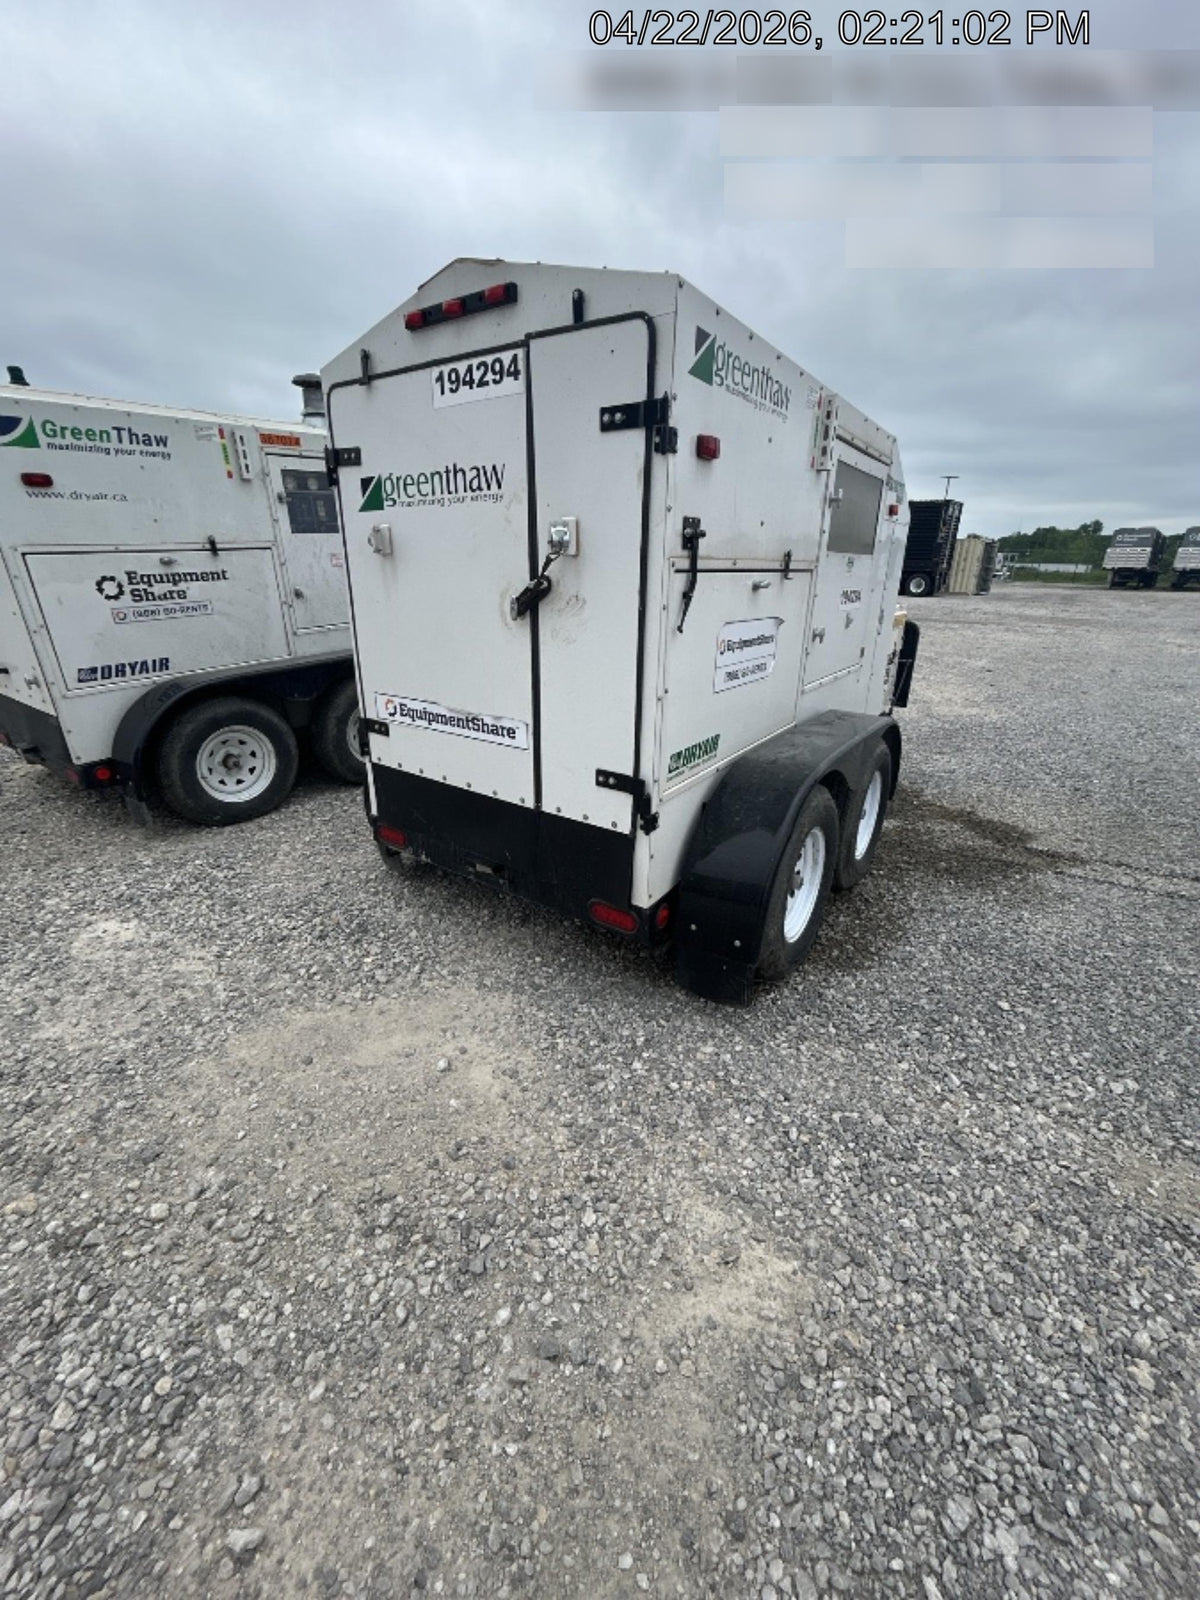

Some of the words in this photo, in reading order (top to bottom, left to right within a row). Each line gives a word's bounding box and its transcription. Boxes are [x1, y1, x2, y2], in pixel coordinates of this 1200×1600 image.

[434, 352, 522, 397] 194294
[714, 342, 792, 411] greenthaw
[40, 419, 168, 448] GreenThaw
[46, 441, 111, 456] maximizing
[113, 446, 137, 457] your
[139, 448, 172, 460] energy
[383, 462, 506, 507] greenthaw
[124, 568, 230, 588] Equipment
[129, 587, 188, 603] Share
[101, 656, 170, 680] DRYAIR
[399, 702, 517, 740] EquipmentShare
